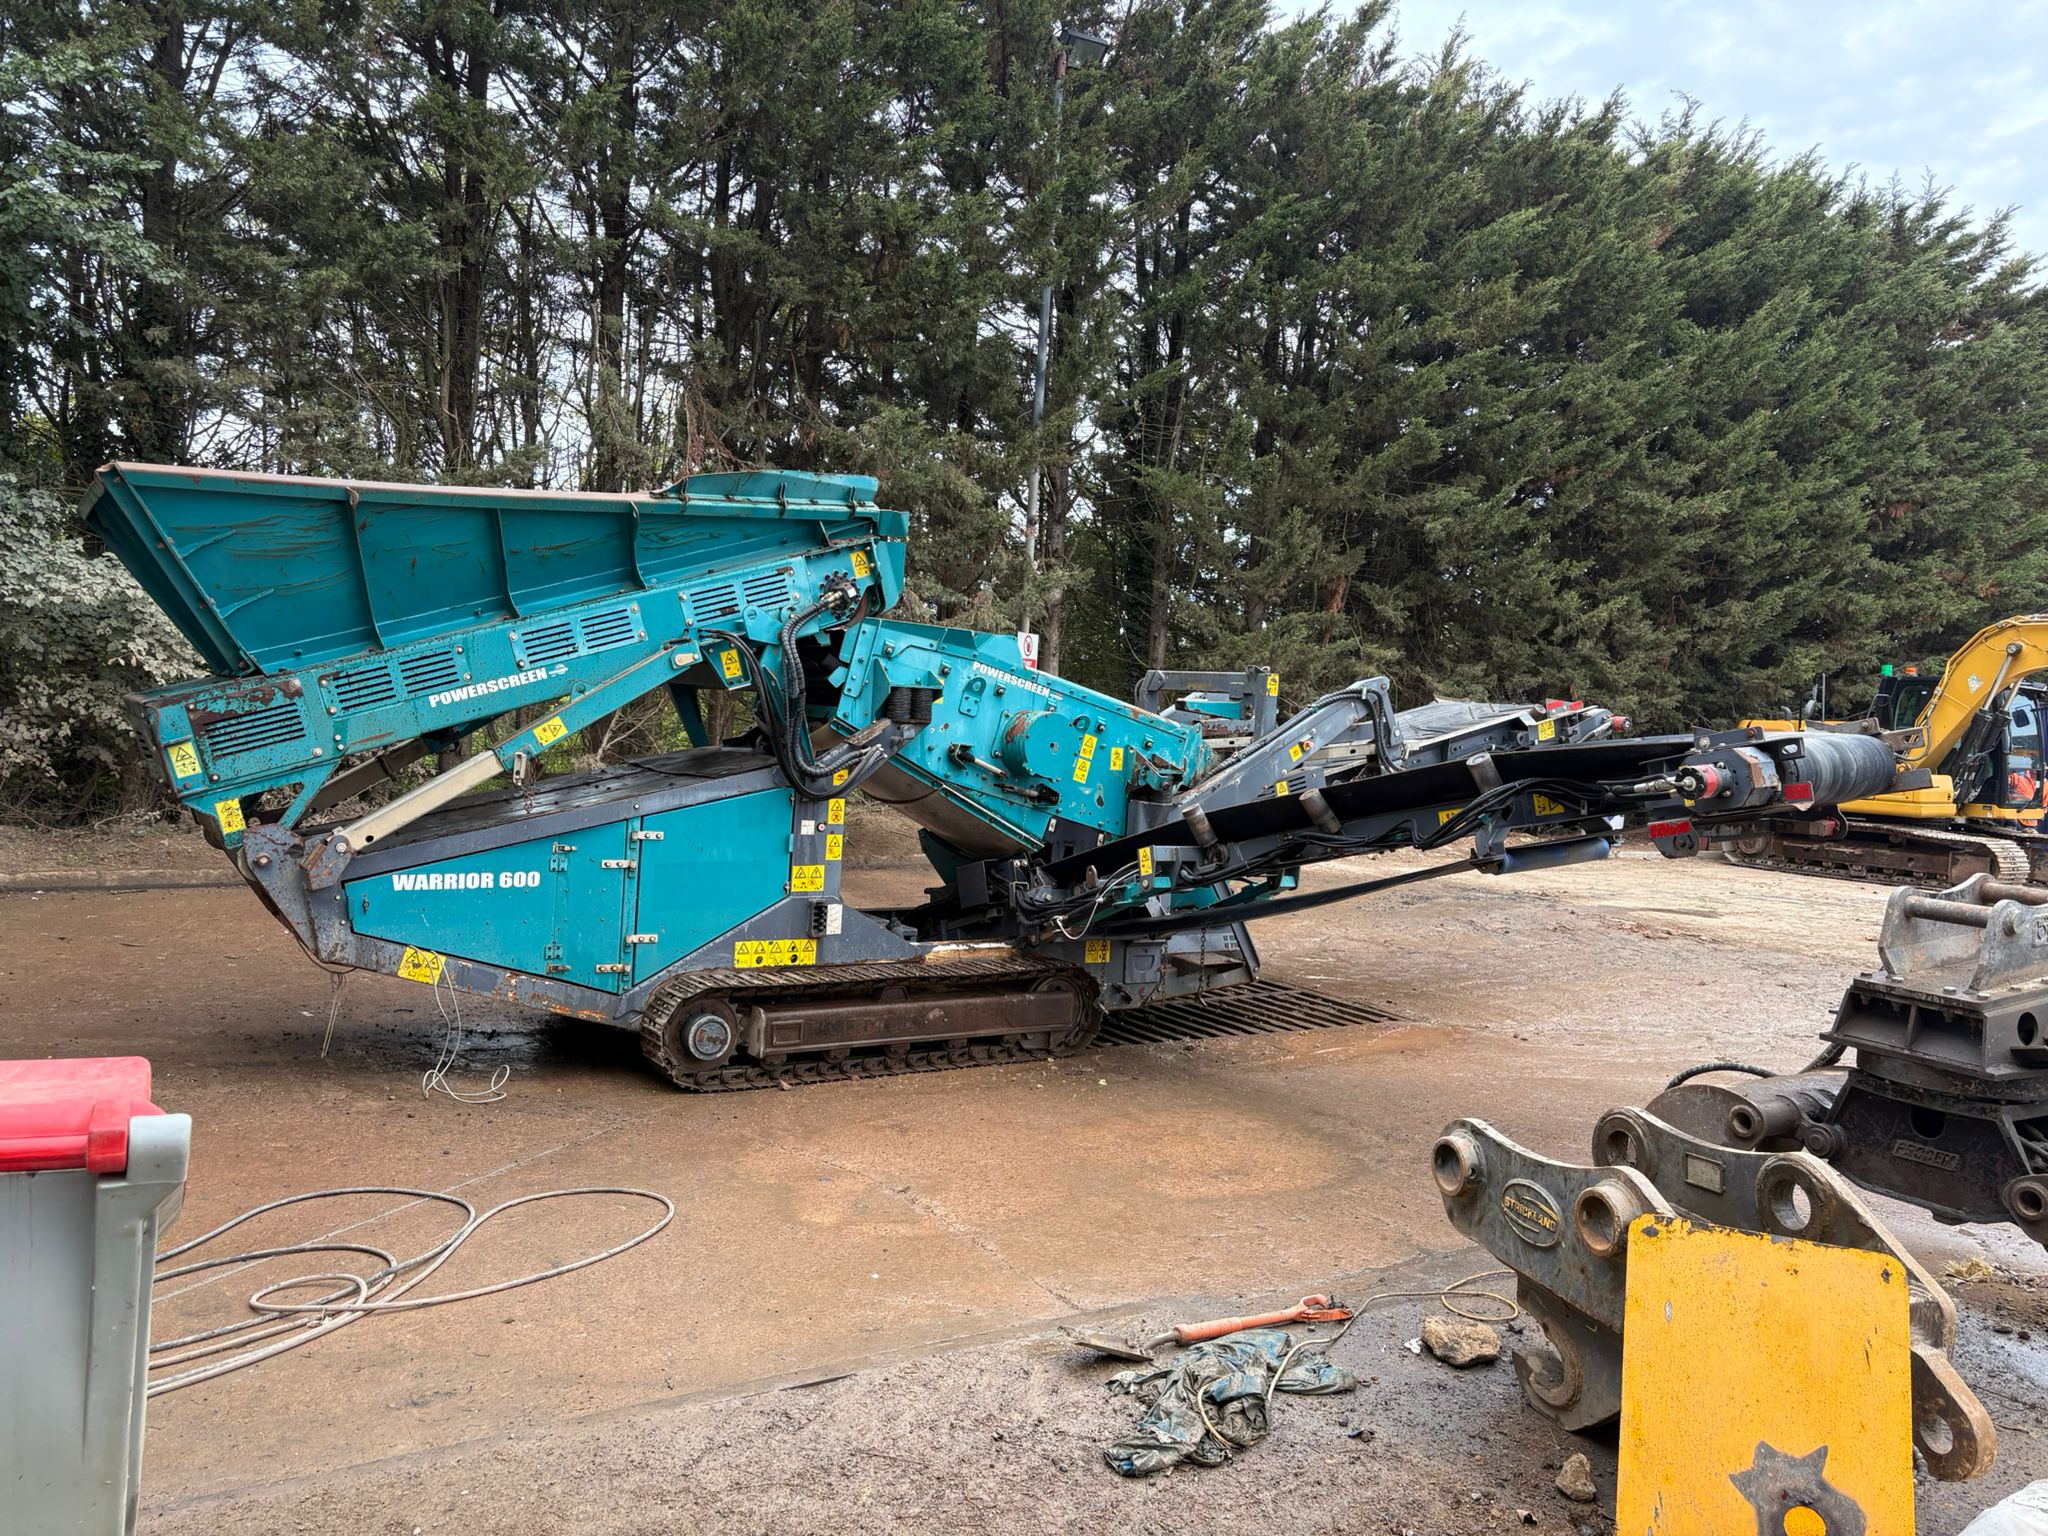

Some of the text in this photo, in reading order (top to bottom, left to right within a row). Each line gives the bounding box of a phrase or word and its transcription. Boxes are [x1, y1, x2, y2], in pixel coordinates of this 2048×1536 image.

[428, 667, 548, 708] POWERSCREEN
[972, 661, 1050, 697] POWERSCREEN
[392, 871, 541, 892] WARRIOR 600
[1503, 1195, 1557, 1232] STRICKLAND
